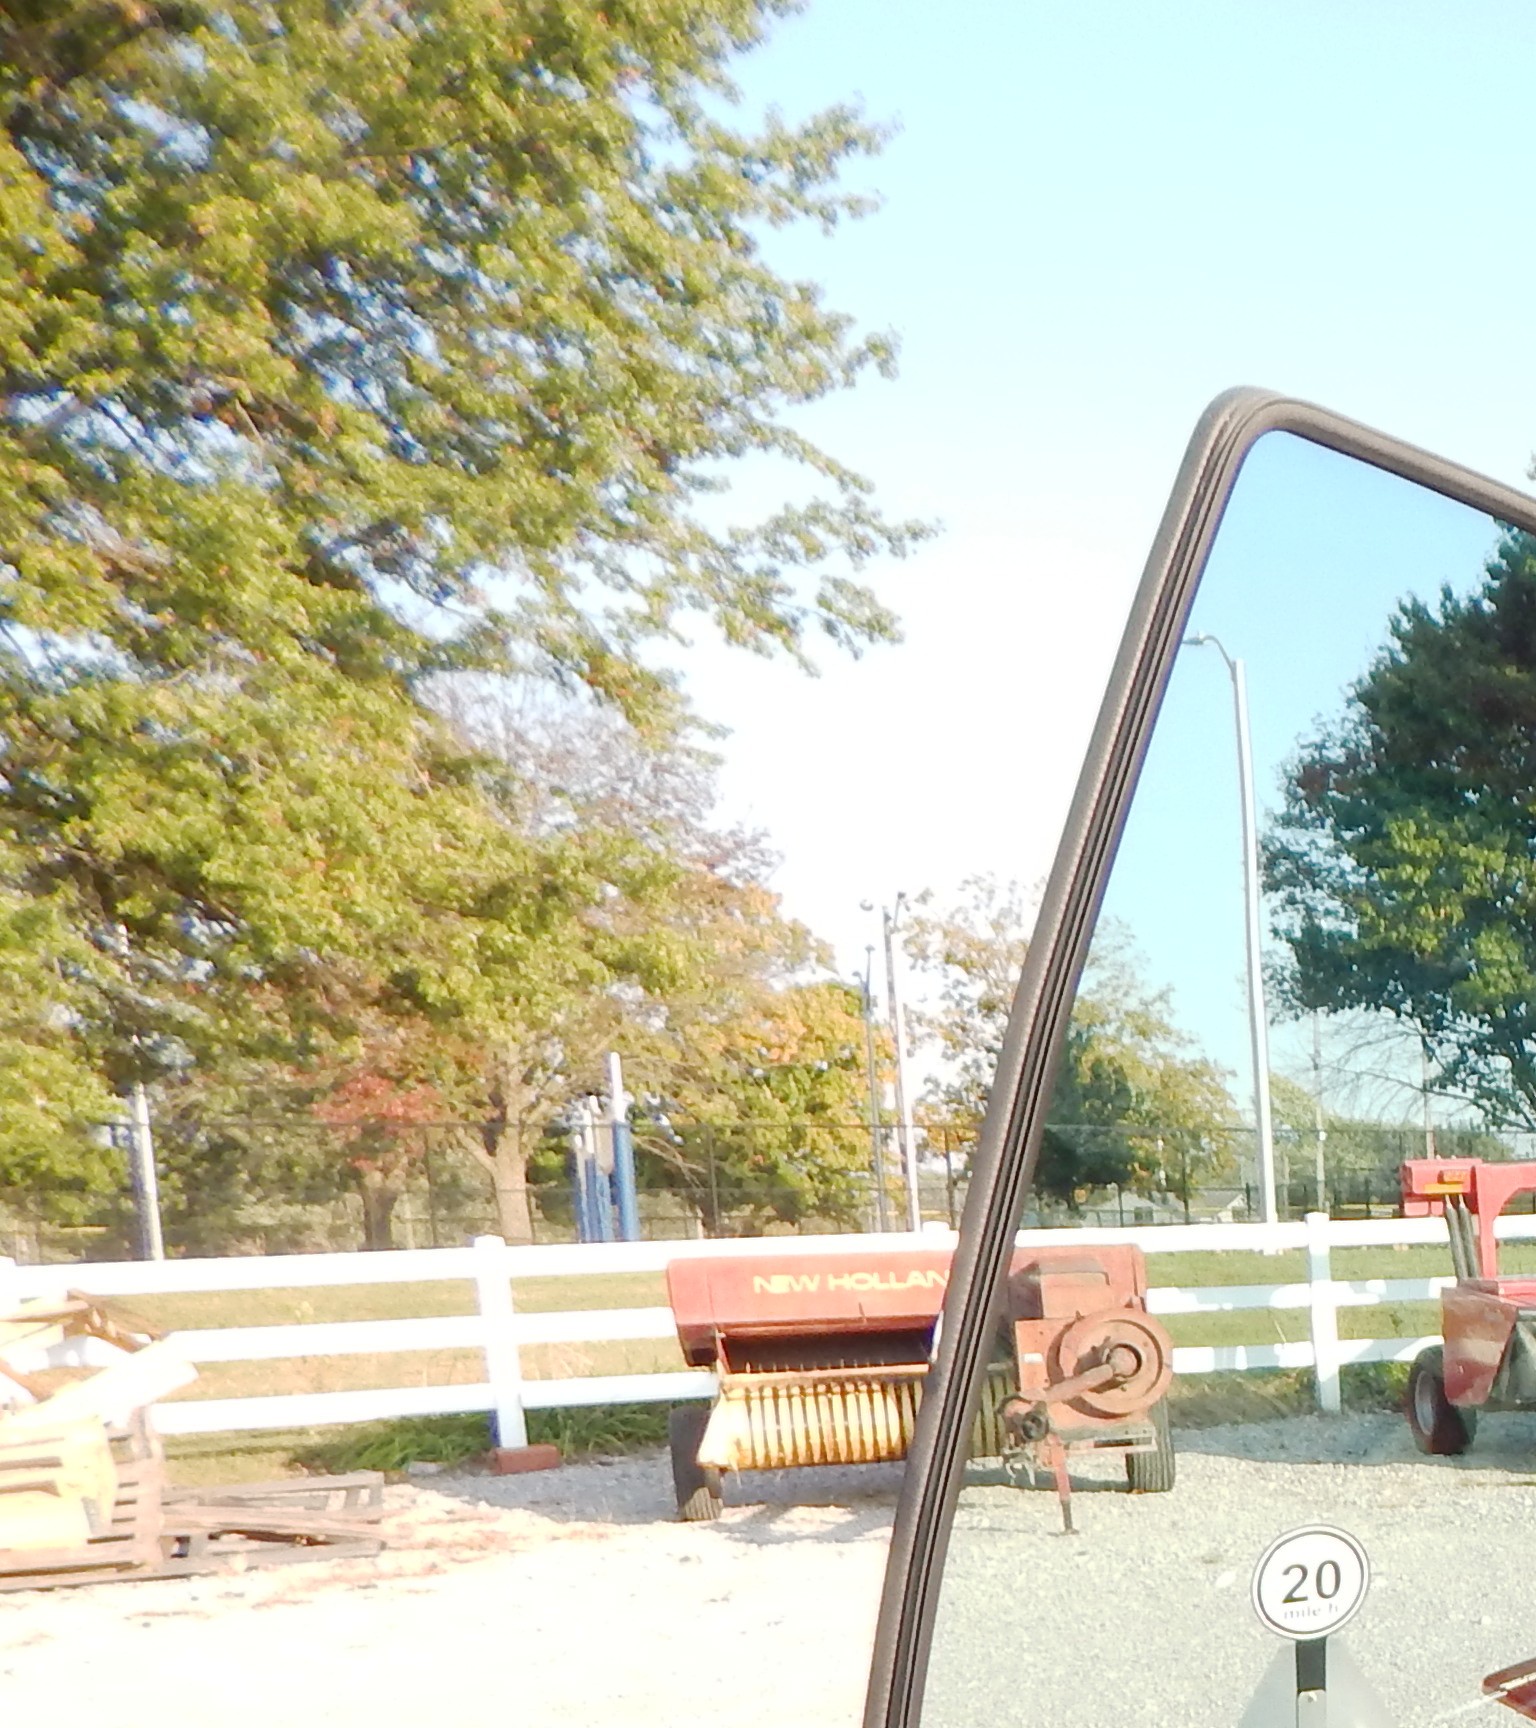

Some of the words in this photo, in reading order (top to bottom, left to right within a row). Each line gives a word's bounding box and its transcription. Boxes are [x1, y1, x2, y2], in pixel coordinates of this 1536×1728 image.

[753, 1274, 820, 1294] NEW
[827, 1269, 951, 1291] HOLLAN
[1282, 1560, 1341, 1604] 20
